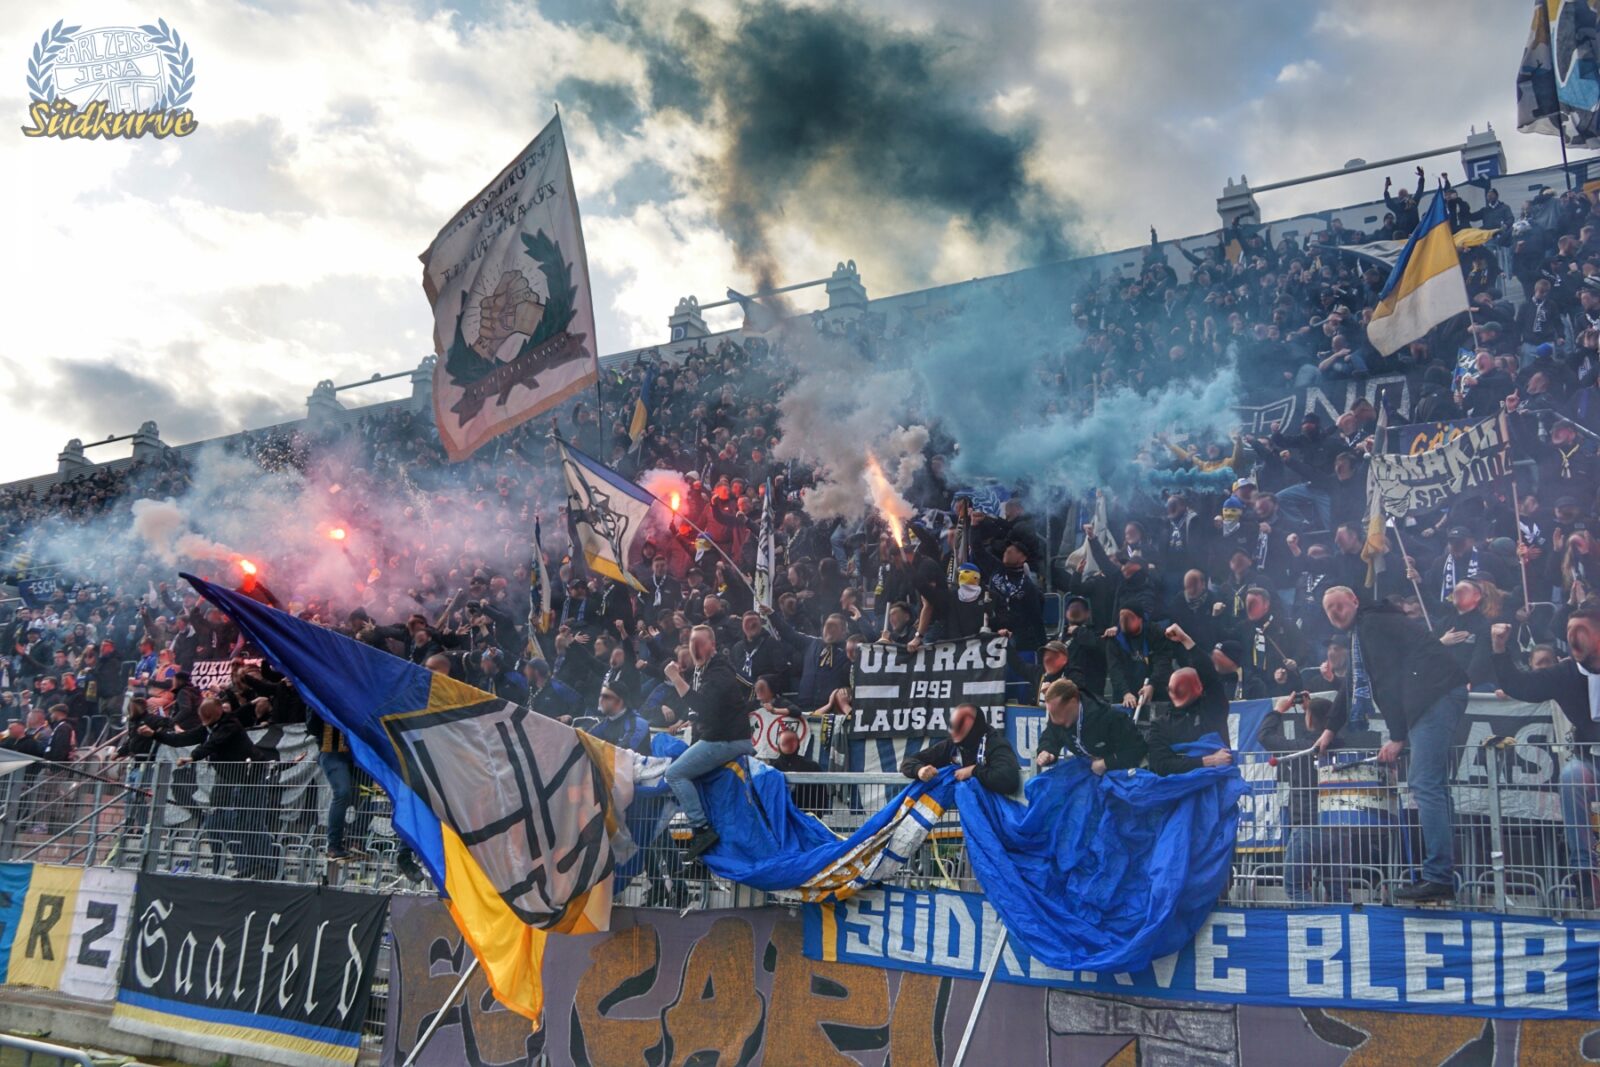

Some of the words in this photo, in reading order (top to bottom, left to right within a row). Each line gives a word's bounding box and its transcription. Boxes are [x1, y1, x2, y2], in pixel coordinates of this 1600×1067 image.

[858, 636, 1009, 674] ULTRAS
[909, 679, 952, 699] 1993
[853, 705, 1006, 732] LAUSAE
[845, 887, 1247, 995] SÜDKE
[135, 899, 364, 1022] Saalfeld
[1095, 1003, 1187, 1041] JENA
